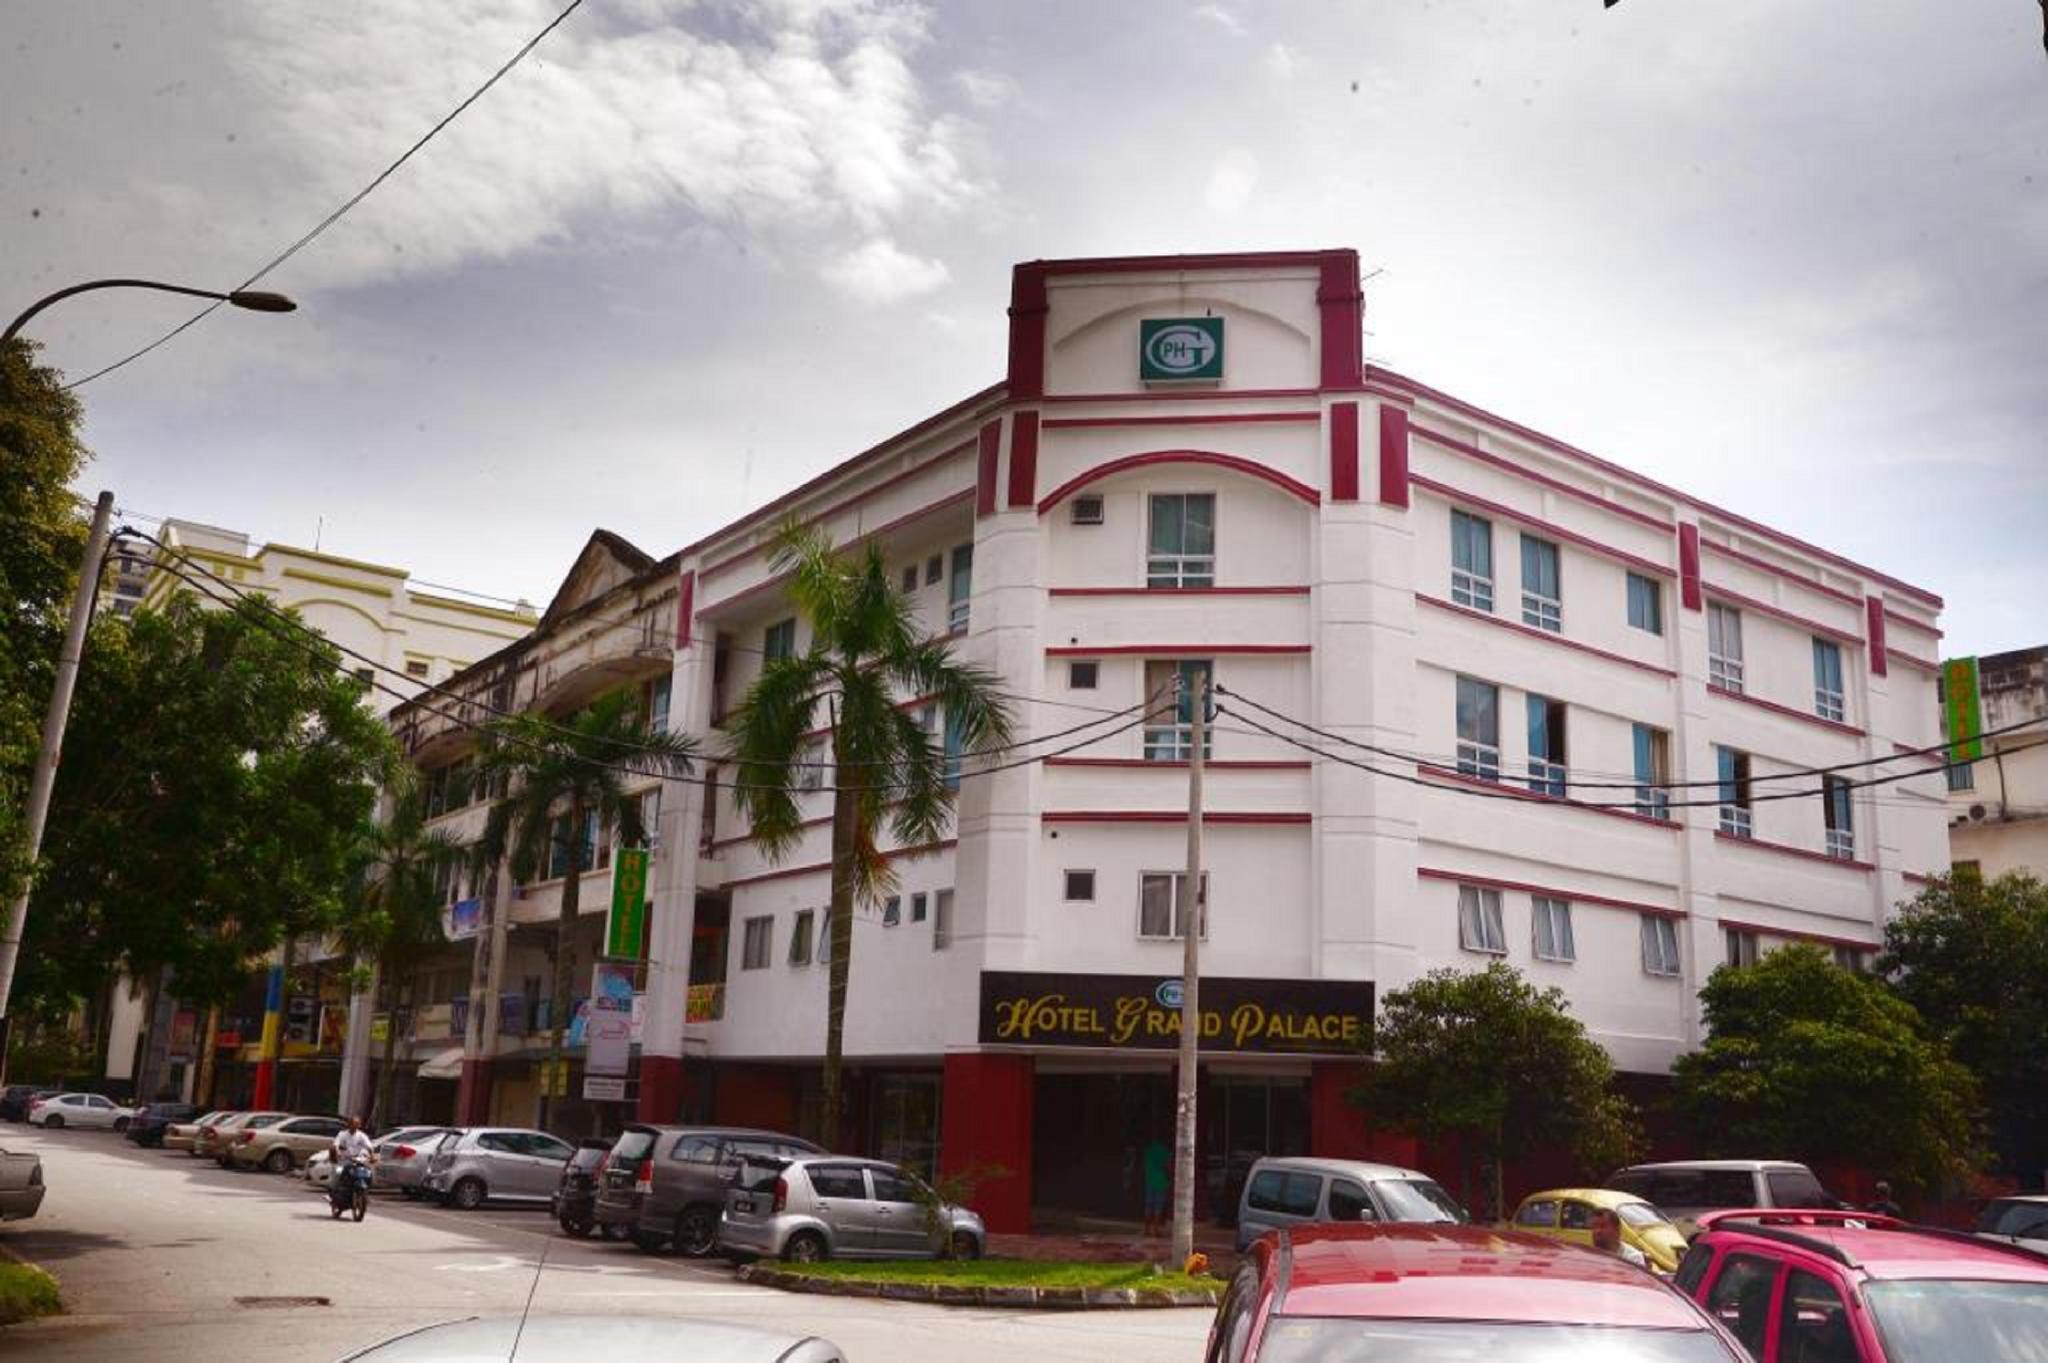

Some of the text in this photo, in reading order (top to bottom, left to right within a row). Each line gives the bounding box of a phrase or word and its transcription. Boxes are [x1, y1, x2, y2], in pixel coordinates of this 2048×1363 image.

[619, 853, 641, 956] HOTEL
[996, 994, 1104, 1039] HOTEL
[1230, 1004, 1360, 1048] PALACE
